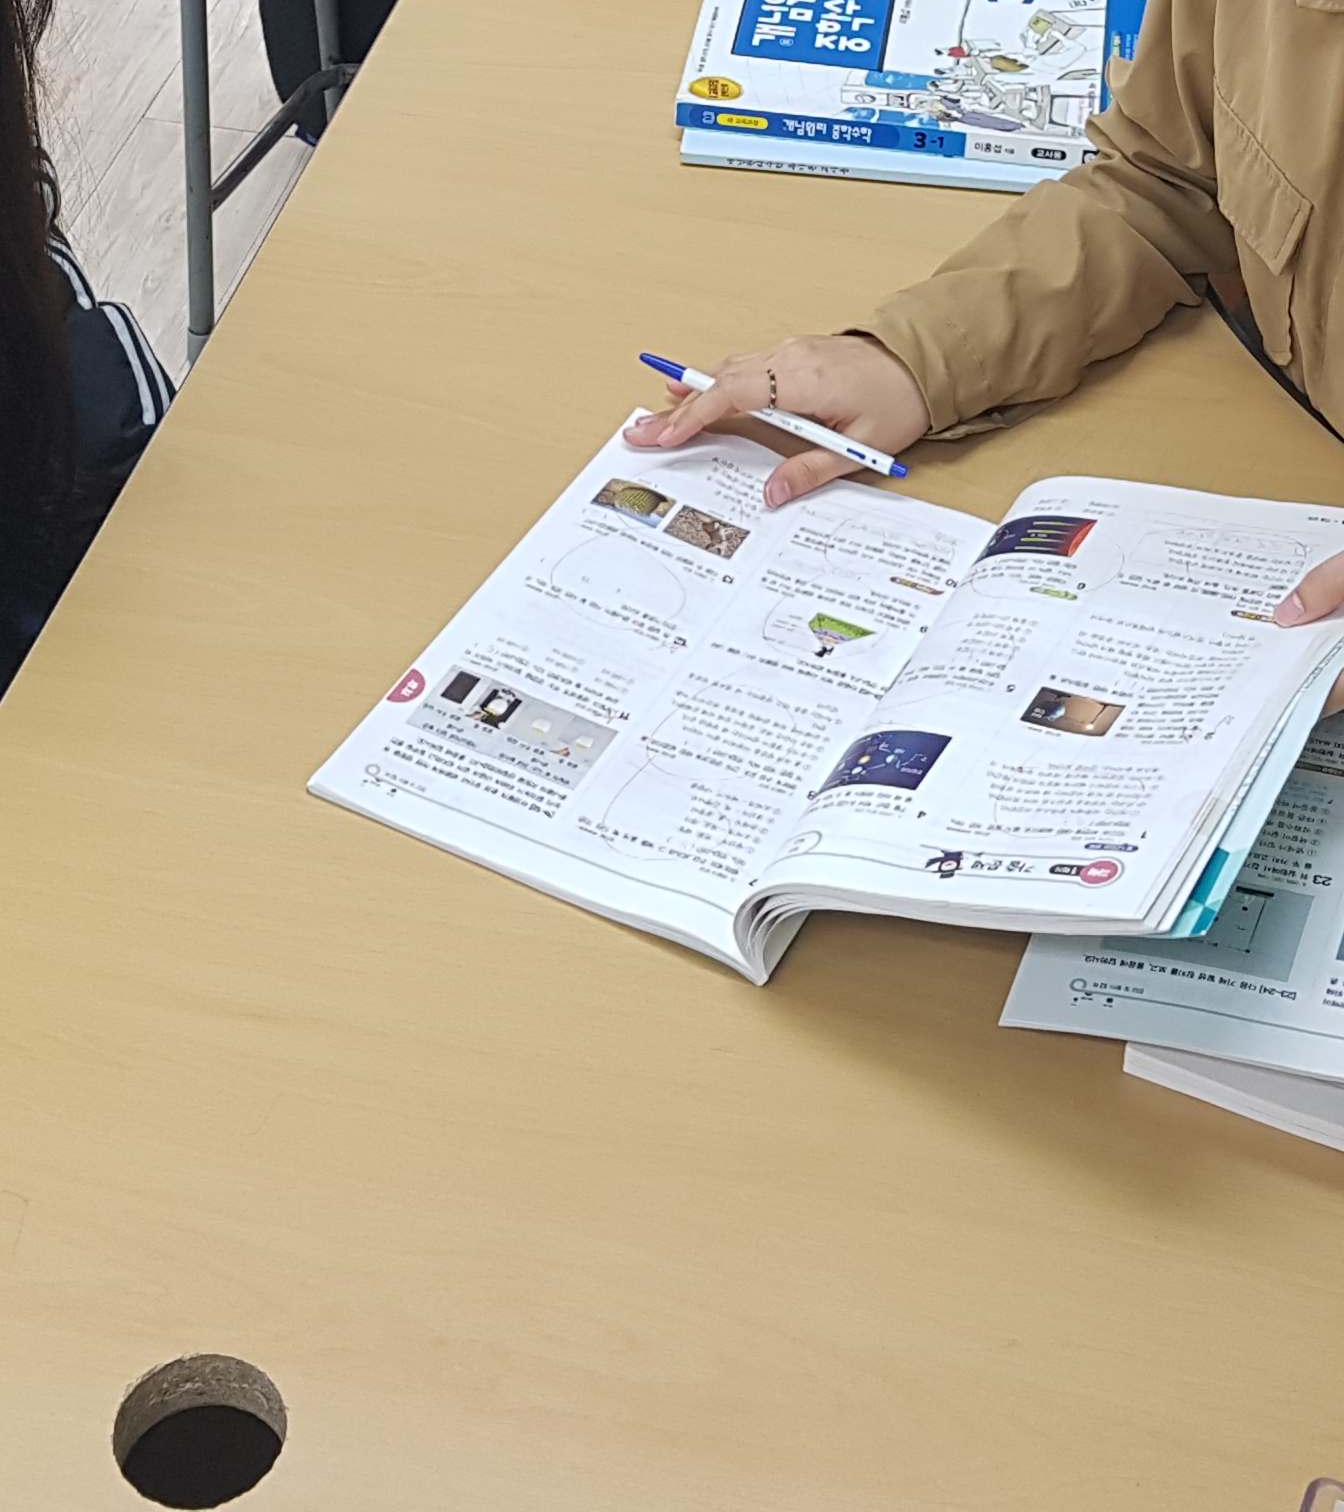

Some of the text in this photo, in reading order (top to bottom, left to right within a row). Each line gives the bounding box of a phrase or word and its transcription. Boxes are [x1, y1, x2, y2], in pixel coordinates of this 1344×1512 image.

[782, 118, 1065, 160] 개념원리 중학수학 3-1 이홍섭 교사용
[1313, 874, 1333, 887] 23
